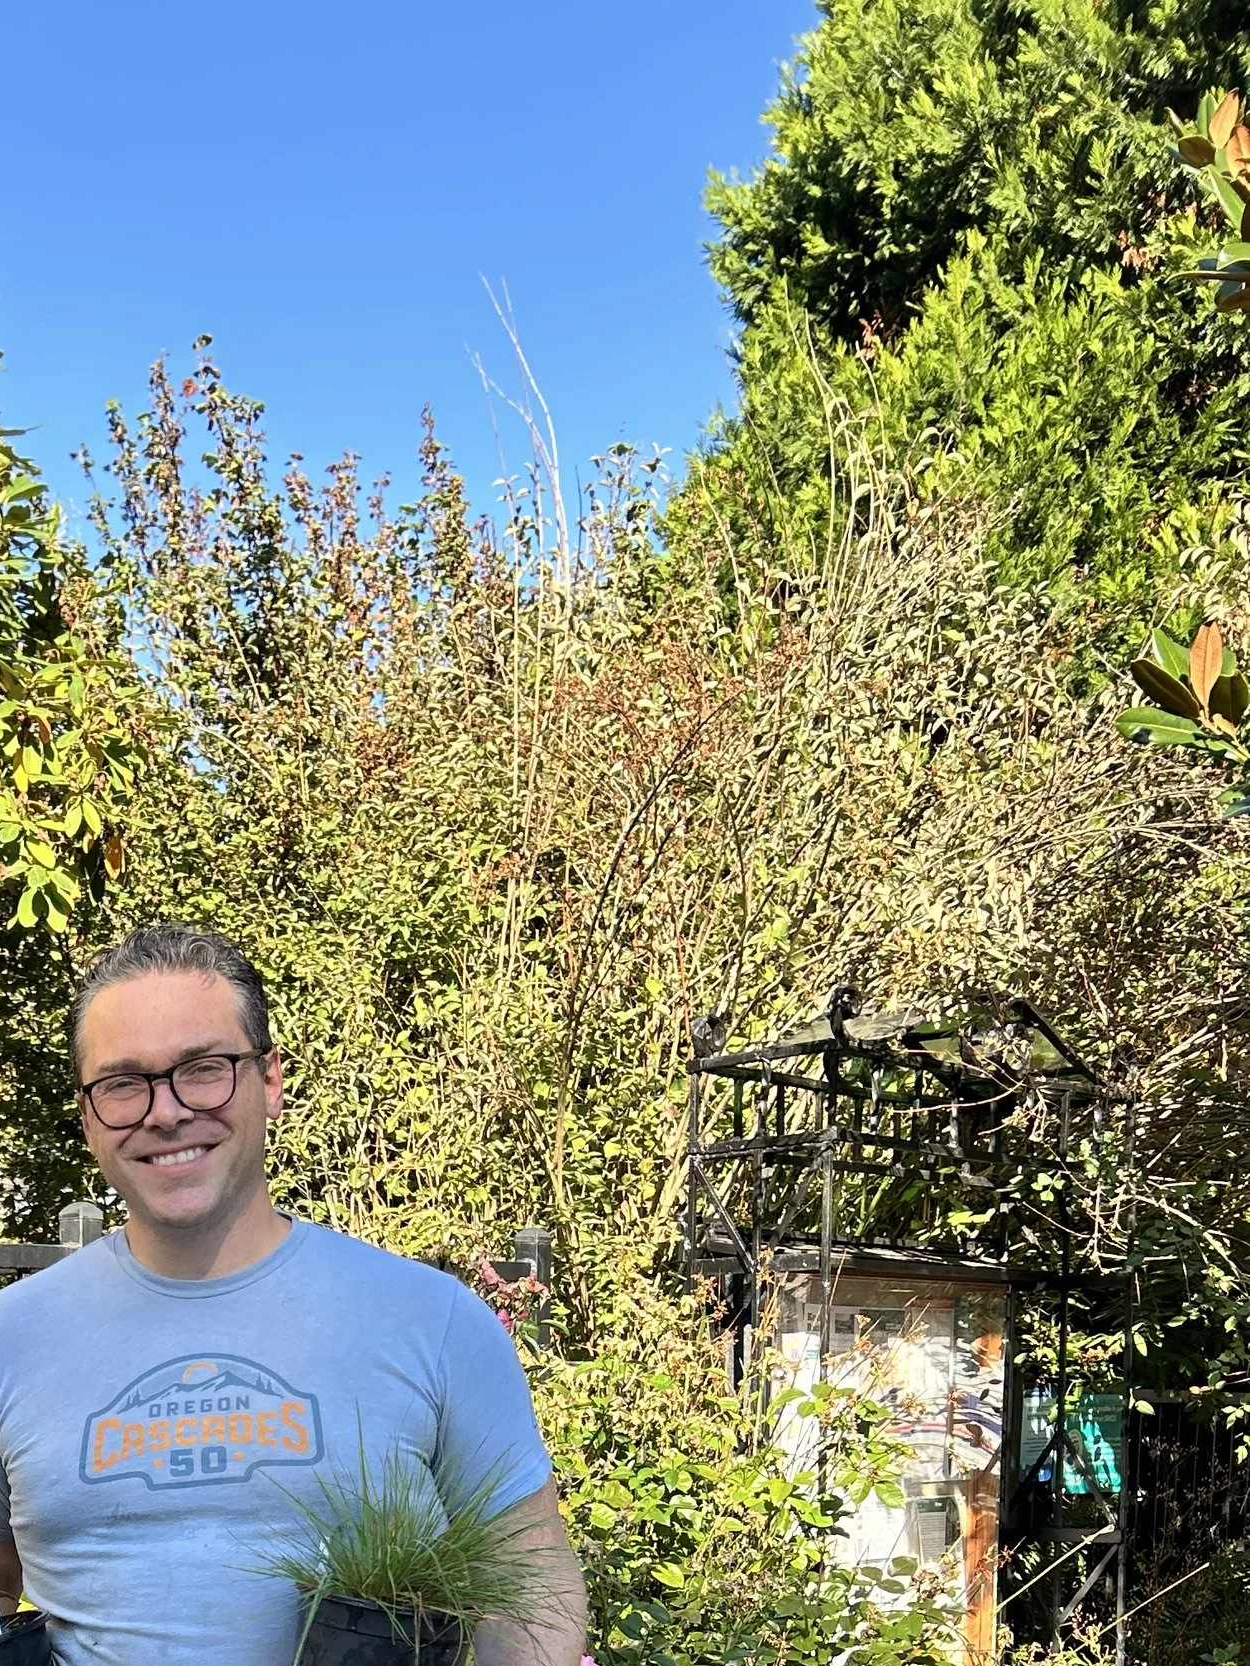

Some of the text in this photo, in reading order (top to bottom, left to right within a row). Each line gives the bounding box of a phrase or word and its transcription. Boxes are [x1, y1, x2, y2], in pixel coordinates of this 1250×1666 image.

[148, 1395, 250, 1418] OREGON
[92, 1402, 310, 1472] CASCADES
[170, 1446, 227, 1477] 50
